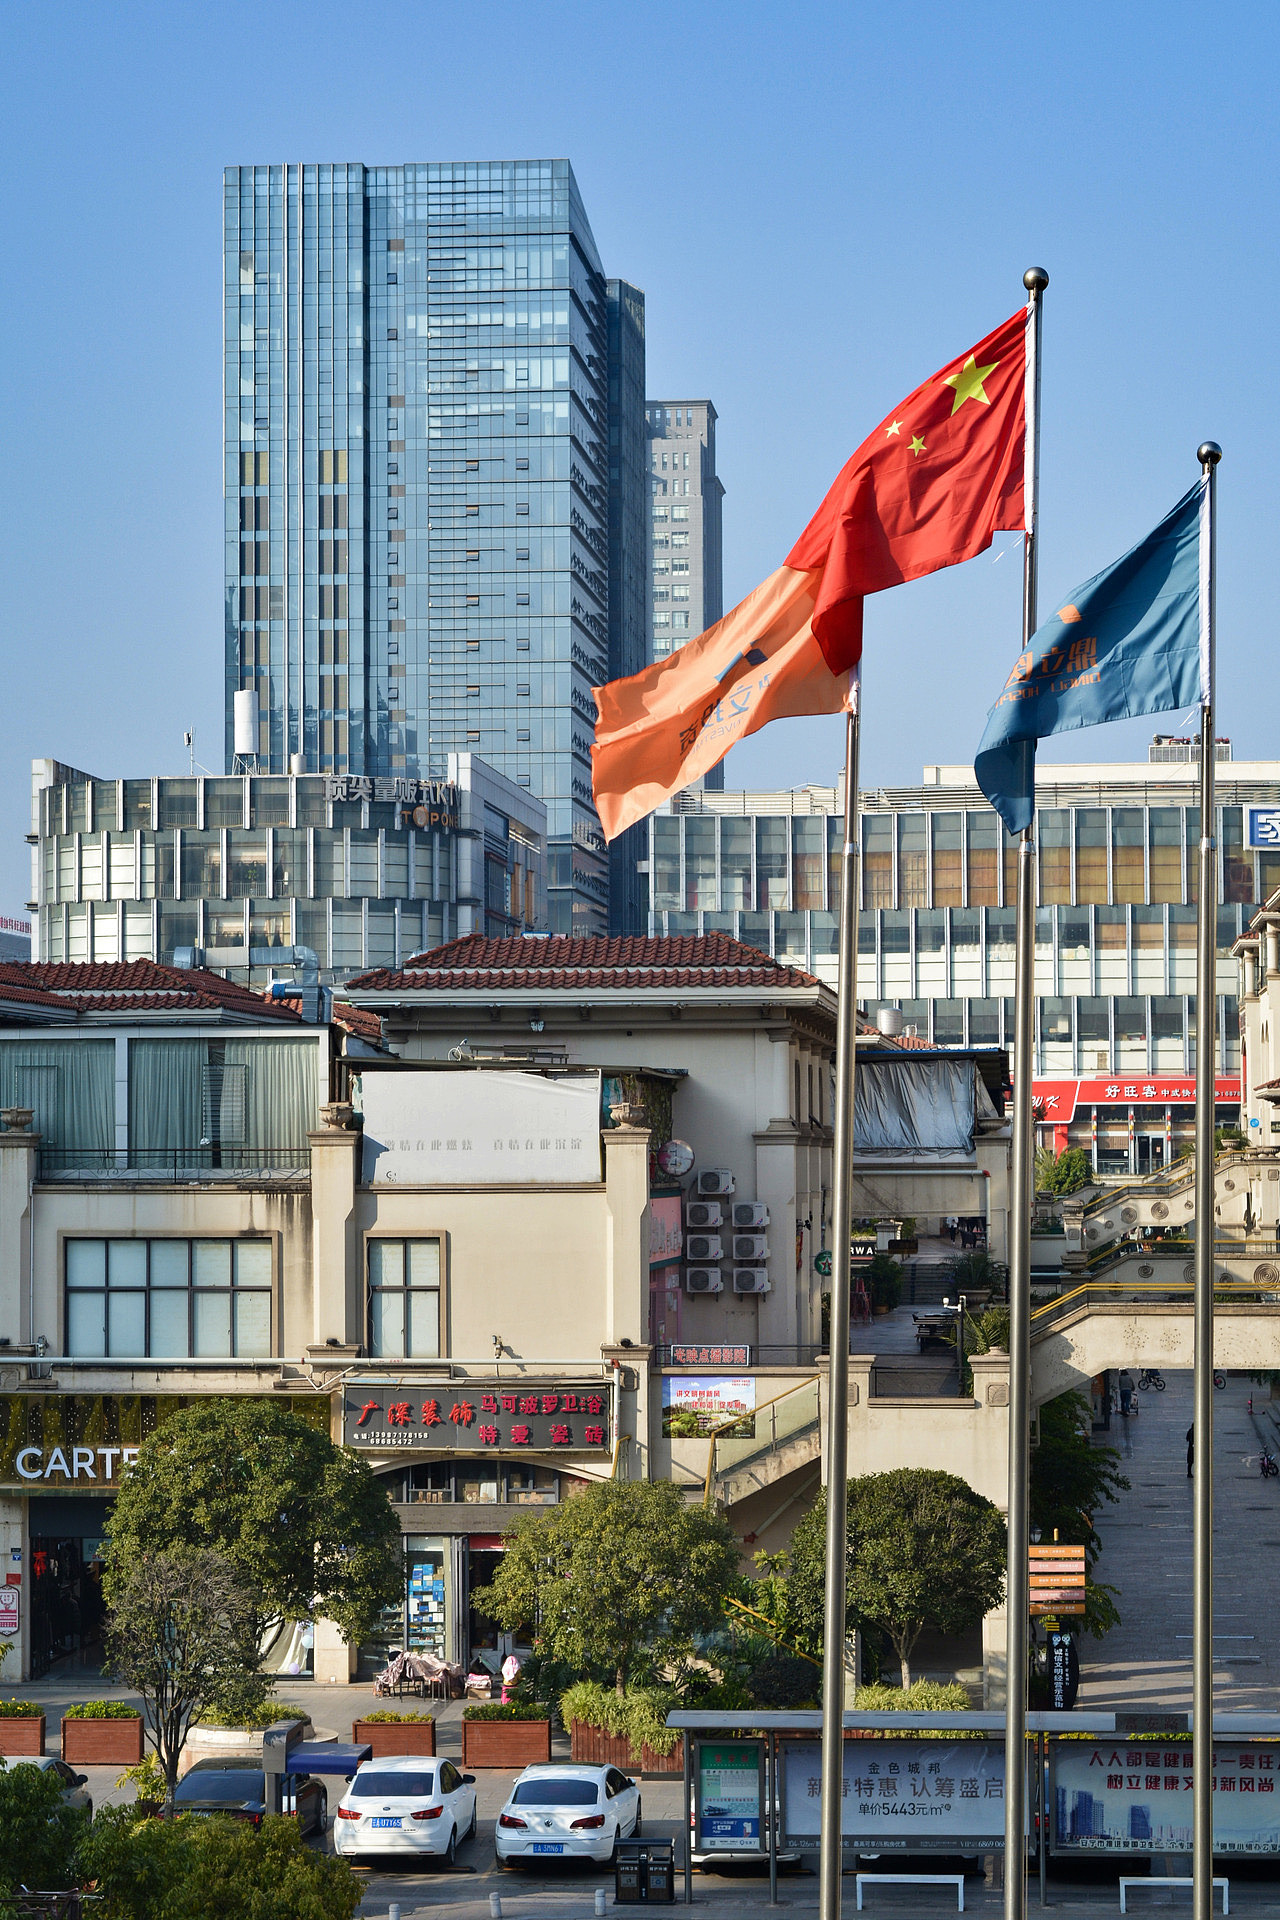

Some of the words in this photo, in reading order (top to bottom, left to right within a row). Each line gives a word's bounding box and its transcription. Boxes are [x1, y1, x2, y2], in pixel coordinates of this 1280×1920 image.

[1105, 1085, 1157, 1098] 好旺客
[674, 1348, 746, 1363] 光映点播影院
[355, 1398, 475, 1427] 广深装饰
[480, 1394, 603, 1414] 马可波罗卫浴
[16, 1447, 148, 1479] CARTE
[1089, 1751, 1280, 1770] 人人都是健康一责任
[1107, 1774, 1274, 1793] 树立健康文新风尚
